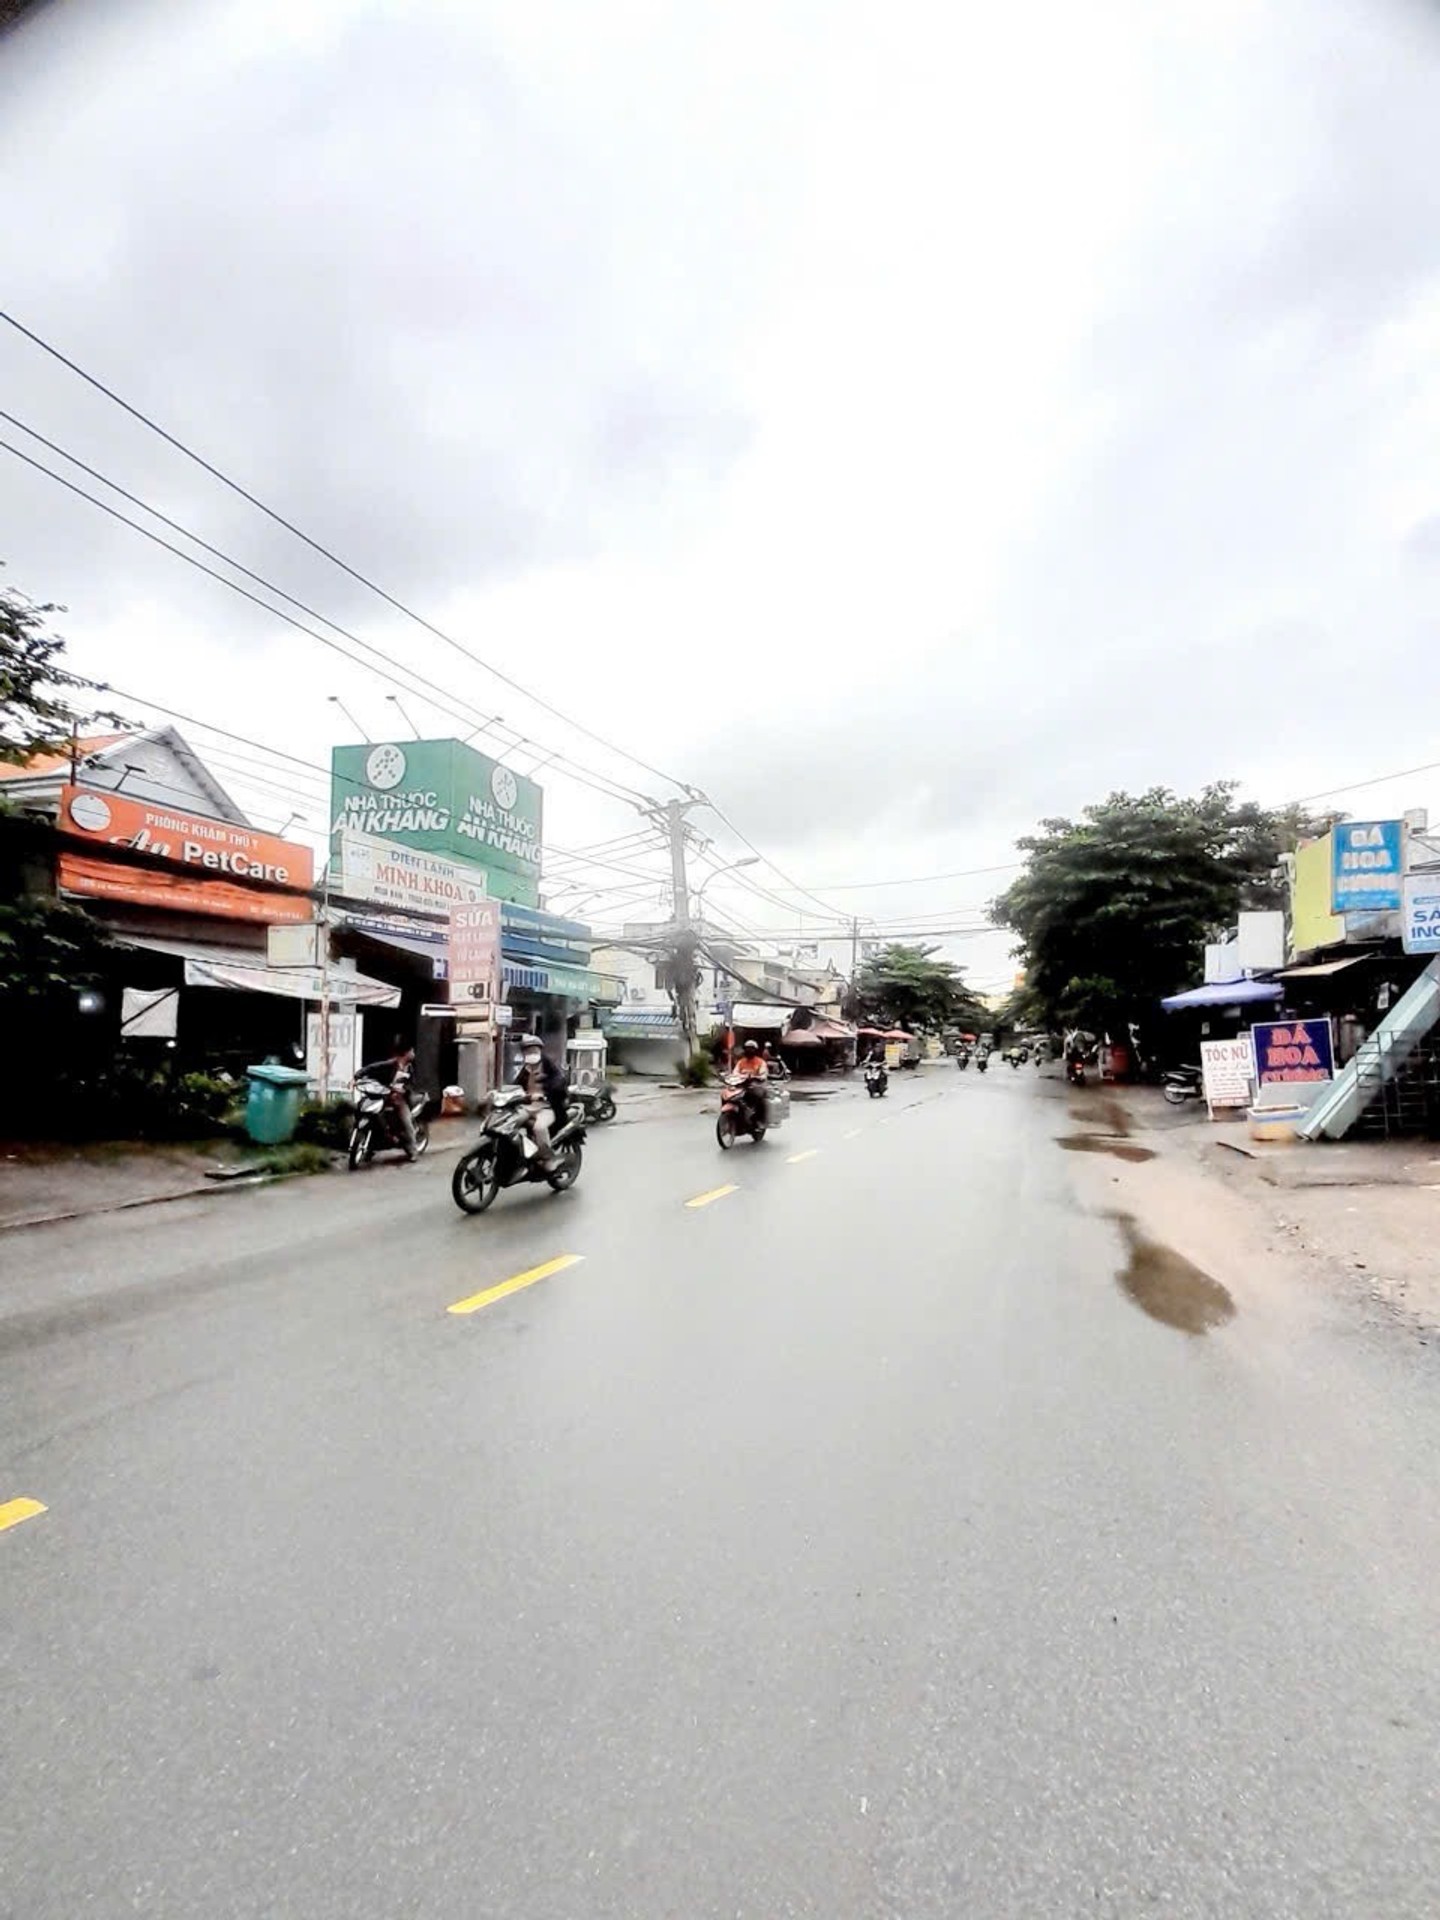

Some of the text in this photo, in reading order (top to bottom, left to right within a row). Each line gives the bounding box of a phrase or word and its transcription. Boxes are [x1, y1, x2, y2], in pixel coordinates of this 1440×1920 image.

[345, 786, 437, 811] NHÀ THUỐC
[469, 796, 495, 821] NHÀ
[146, 812, 189, 834] PHÒNG
[184, 840, 290, 884] PetCare
[376, 863, 419, 890] MINH
[423, 876, 463, 901] KHOA
[1205, 1042, 1248, 1062] TÓC NỮ
